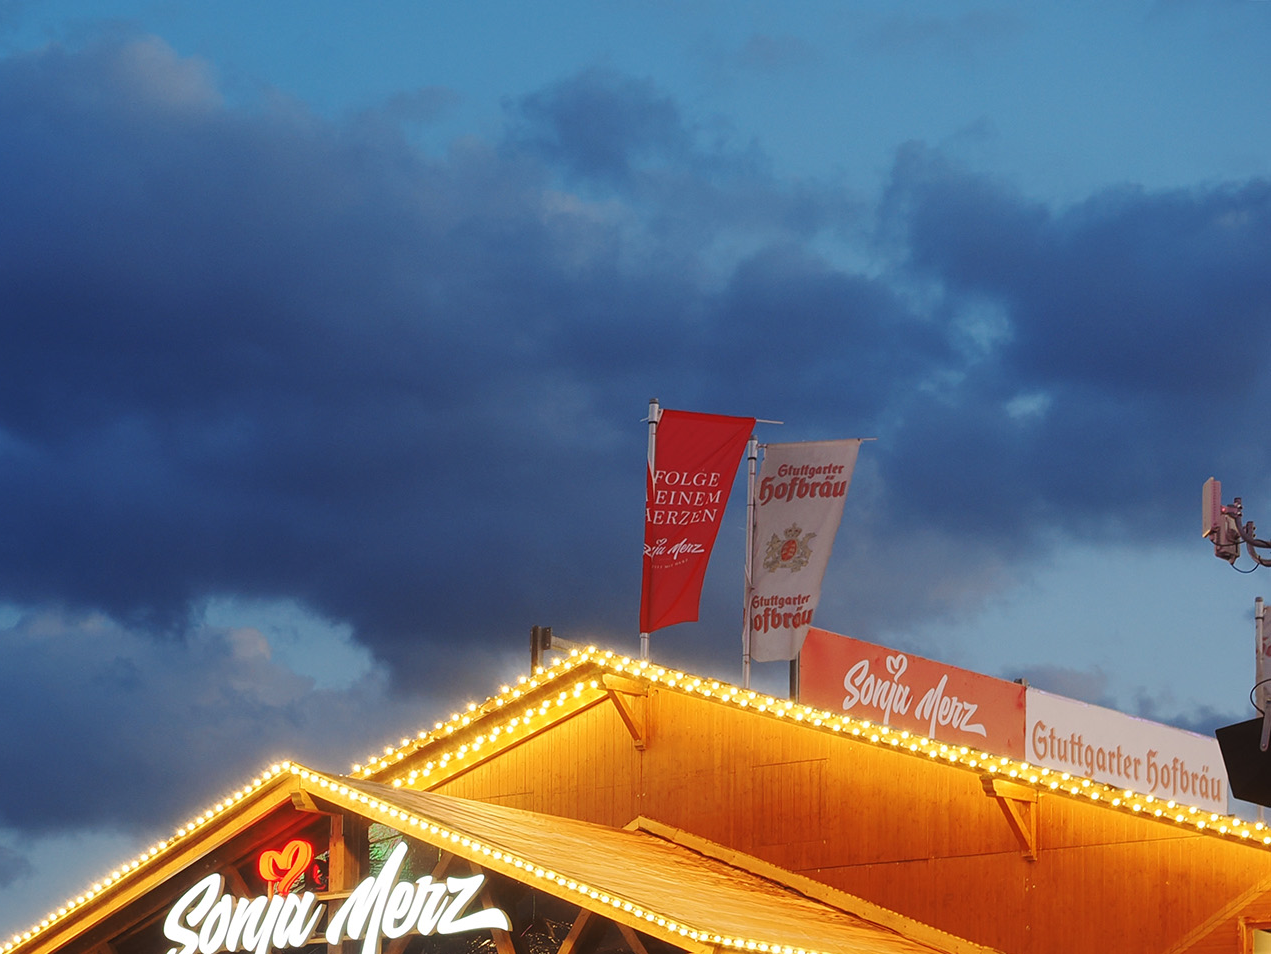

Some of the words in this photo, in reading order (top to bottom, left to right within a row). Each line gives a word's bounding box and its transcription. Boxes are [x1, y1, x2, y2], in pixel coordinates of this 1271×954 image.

[655, 470, 720, 487] FOLGE
[778, 463, 844, 479] Stuttgarter
[646, 489, 722, 506] EINEM
[752, 593, 811, 609] Stuttgarter
[753, 606, 813, 634] ofbräu
[842, 655, 914, 725] Sonja
[915, 674, 987, 740] Merz
[1032, 719, 1142, 780] Stuttgarter
